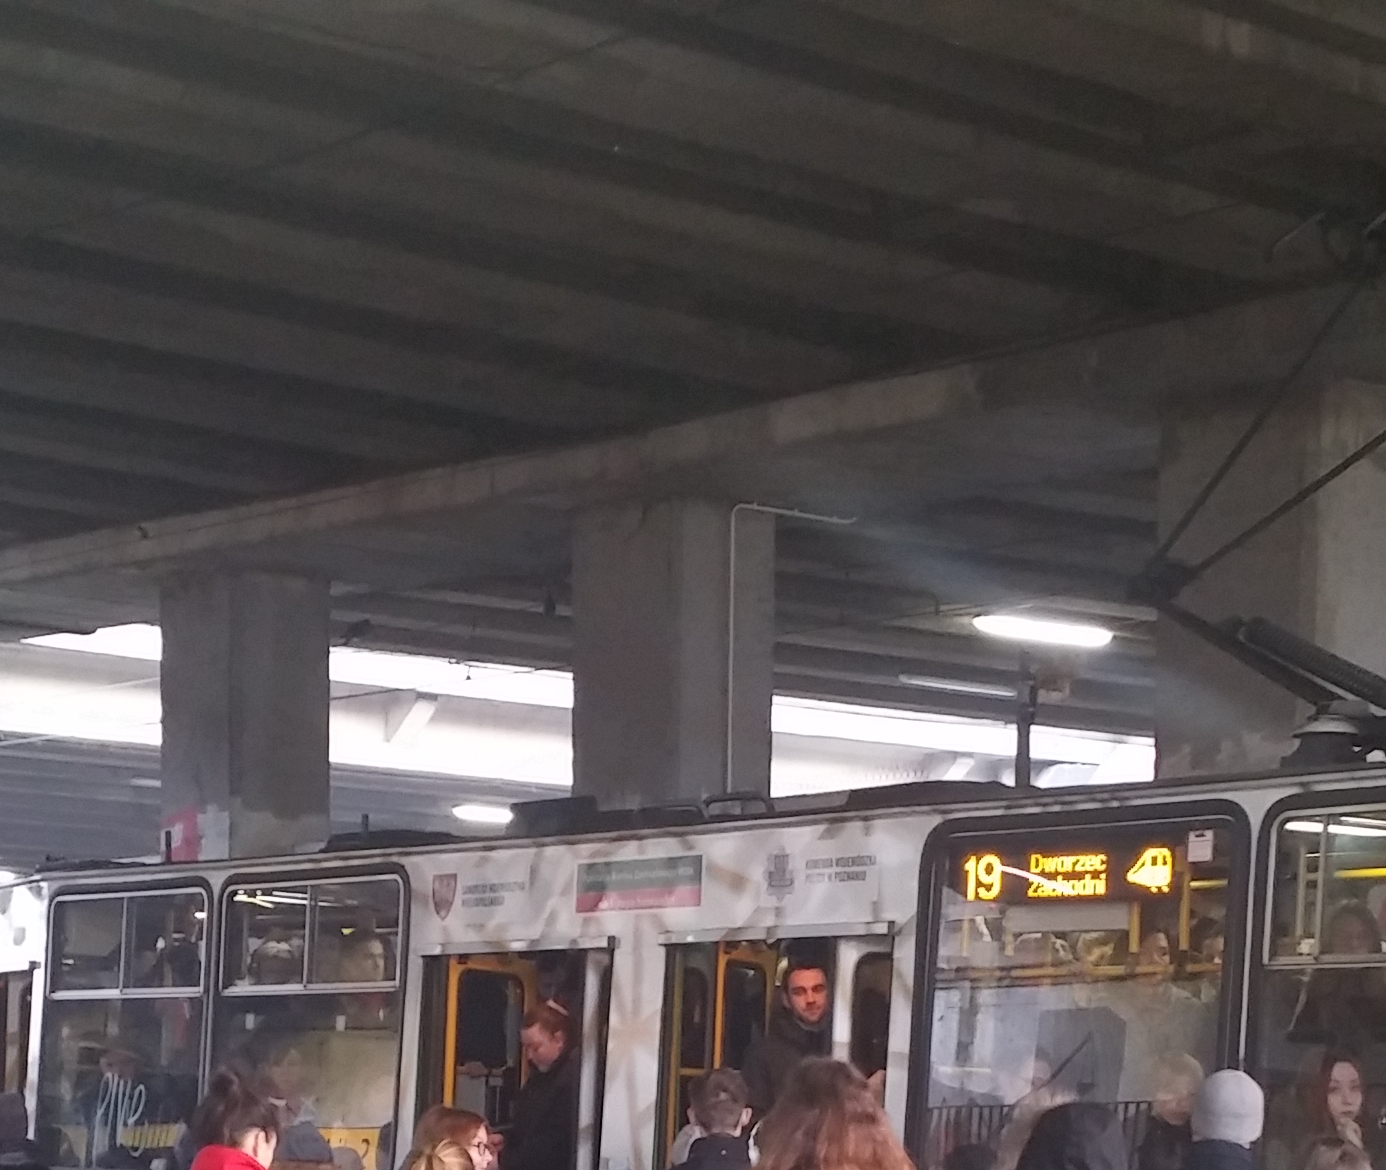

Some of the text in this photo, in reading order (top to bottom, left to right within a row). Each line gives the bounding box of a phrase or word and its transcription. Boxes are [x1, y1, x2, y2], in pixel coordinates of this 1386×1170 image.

[1029, 854, 1107, 873] Dworzec
[964, 854, 1002, 901] 19
[1028, 874, 1107, 898] Zachodni
